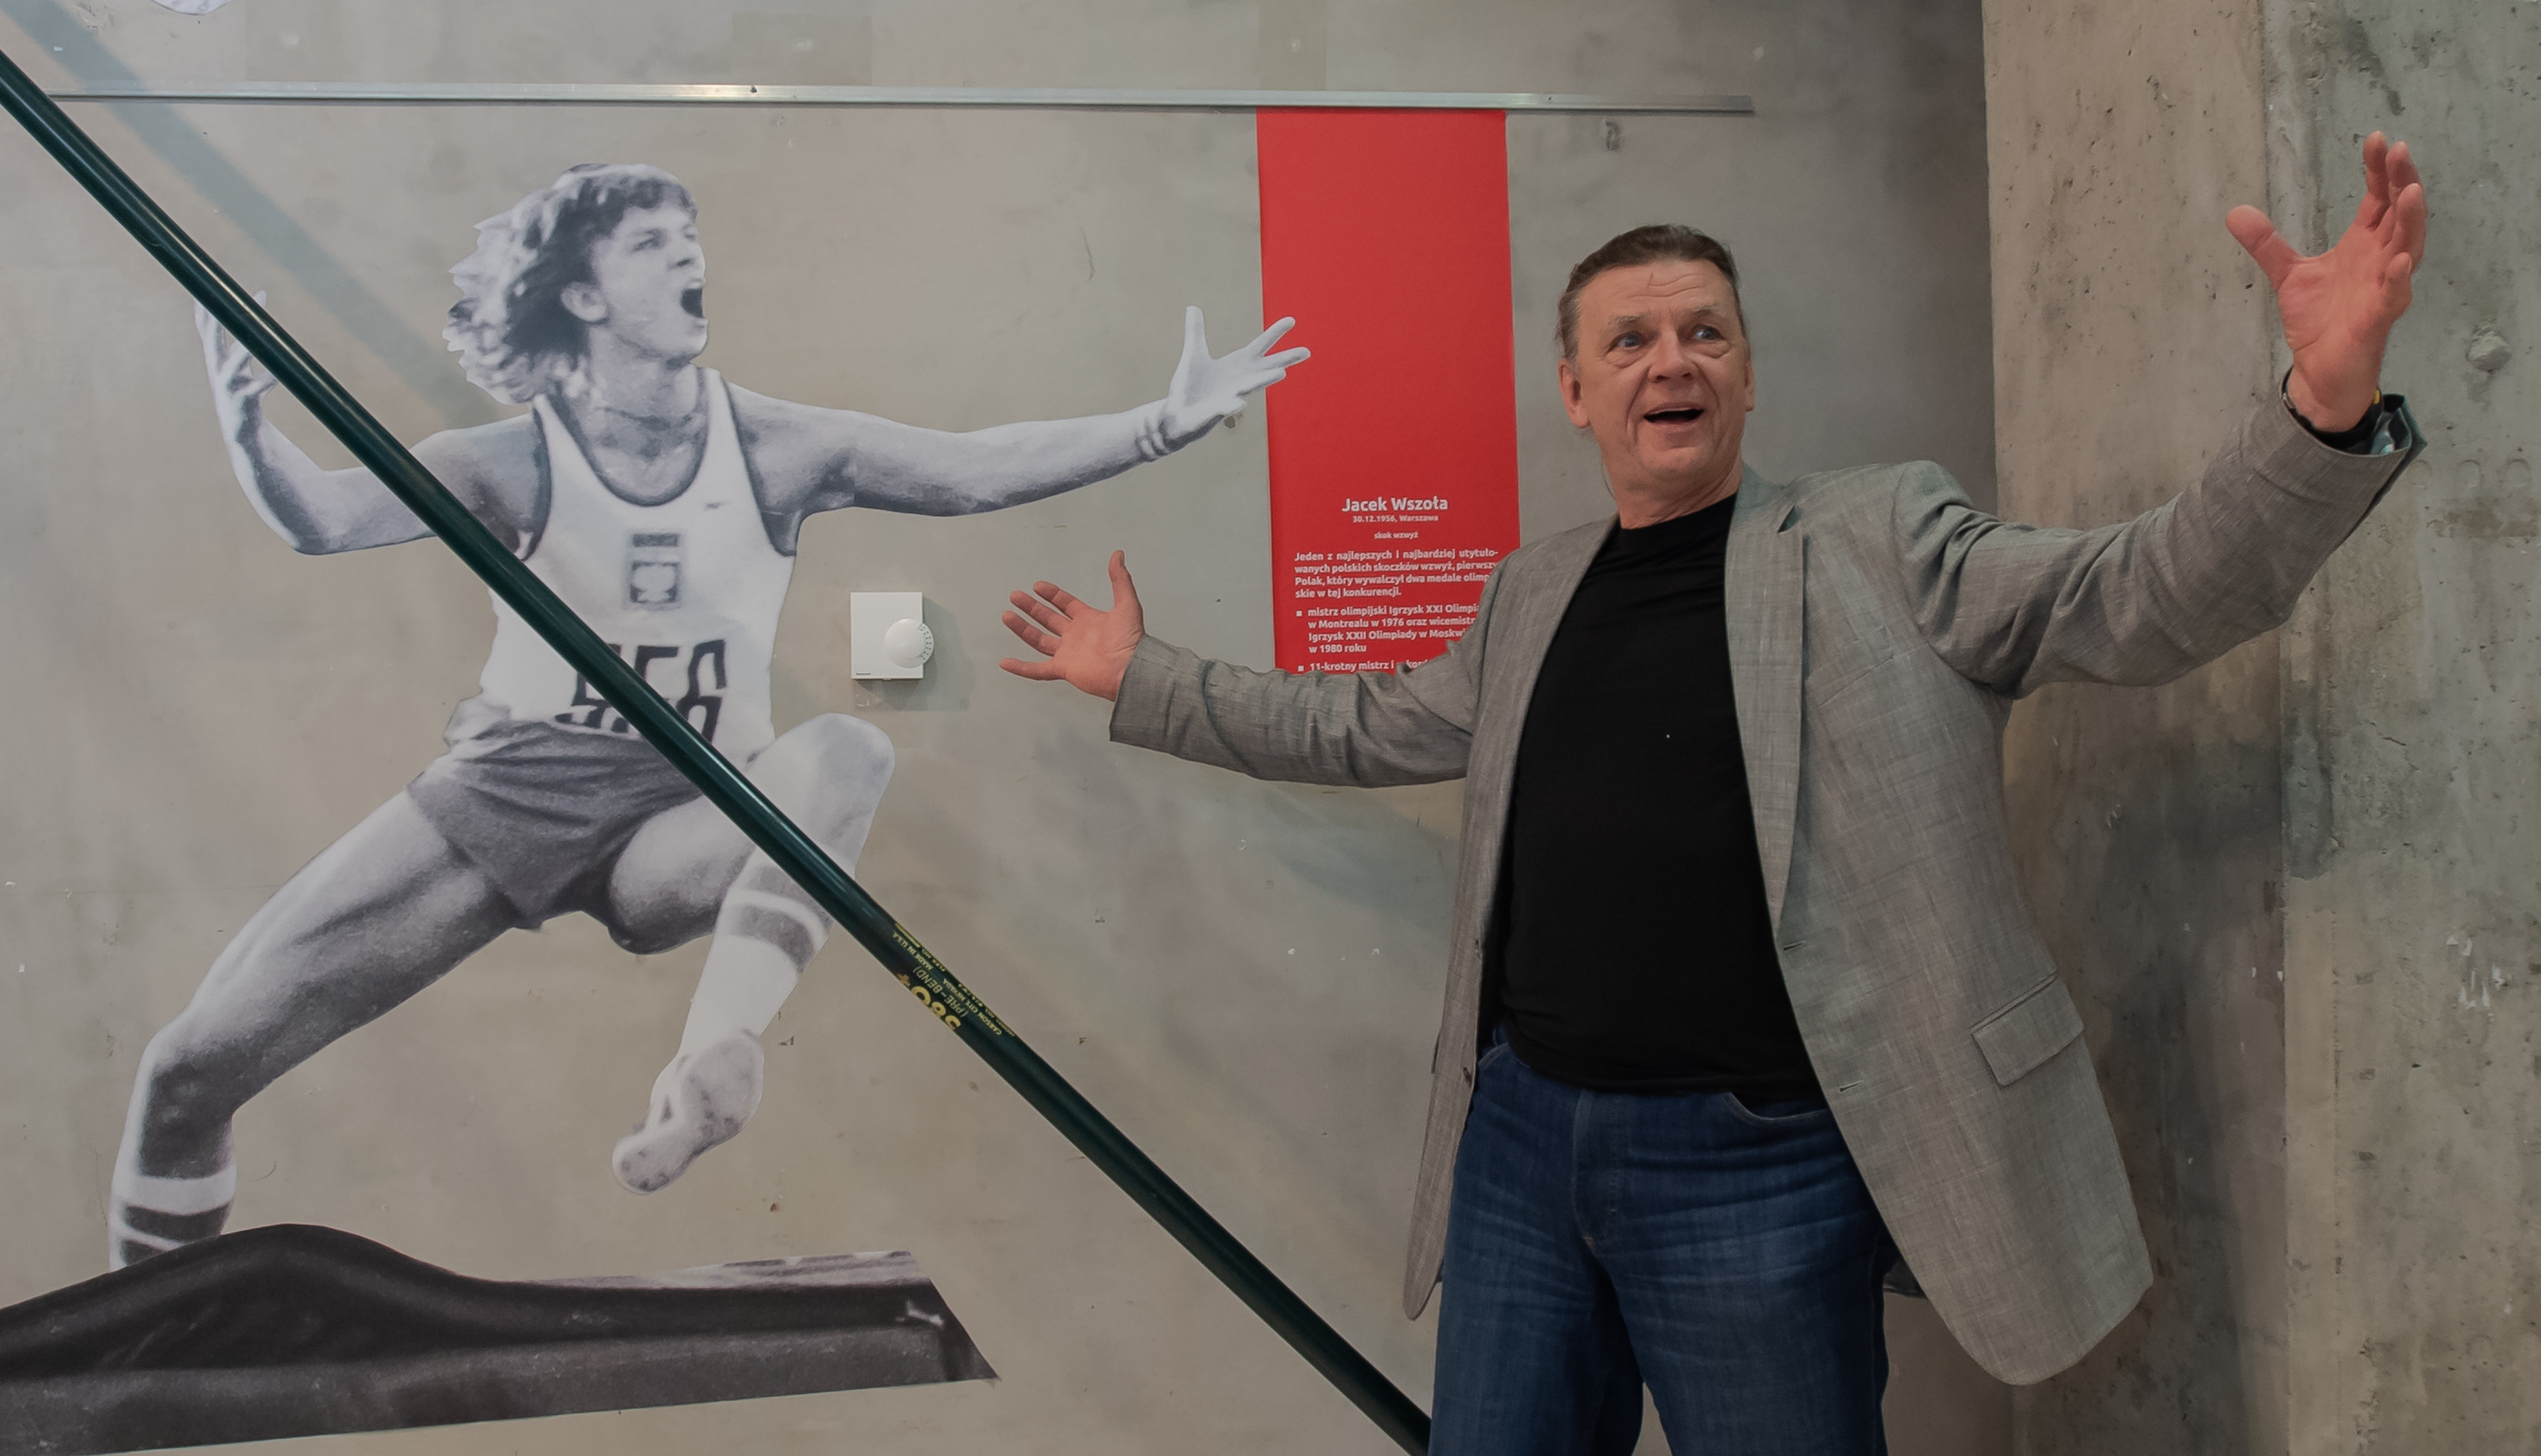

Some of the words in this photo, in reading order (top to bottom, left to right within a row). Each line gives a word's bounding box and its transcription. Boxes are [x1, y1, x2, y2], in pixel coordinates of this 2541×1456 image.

[1341, 496, 1388, 512] Jacek
[1390, 495, 1448, 511] Wszoła
[1374, 531, 1392, 539] skok
[1294, 552, 1324, 562] Jeden
[1336, 550, 1392, 562] najlepszych
[1396, 549, 1400, 559] i
[1402, 548, 1455, 560] najbardziej
[1294, 563, 1330, 575] wanych
[1332, 562, 1373, 575] polskich
[1373, 562, 1419, 572] skoczków
[1420, 560, 1455, 572] wzwyż,
[1295, 576, 1326, 586] Polak,
[1326, 575, 1353, 586] który
[1405, 573, 1426, 583] dwa
[1426, 573, 1462, 583] medale
[1463, 572, 1489, 583] olimp
[1295, 588, 1315, 598] skie
[1327, 588, 1341, 599] tej
[1343, 586, 1402, 598] konkurencji.
[1307, 607, 1339, 617] mistrz
[1340, 605, 1387, 617] olimpijski
[1389, 604, 1424, 616] Igrzysk
[1426, 605, 1443, 613] XXI
[1318, 618, 1369, 628] Montrealu
[1381, 617, 1404, 627] 1976
[1428, 615, 1477, 626] wicemistr
[1309, 631, 1344, 643] Igrzysk
[1345, 631, 1366, 641] XXII
[1368, 629, 1417, 641] Olimpiady
[1319, 644, 1343, 654] 1980
[1344, 643, 1367, 653] roku
[1309, 662, 1357, 673] 11-krotny
[1358, 660, 1389, 670] mistrz
[1391, 660, 1394, 669] i
